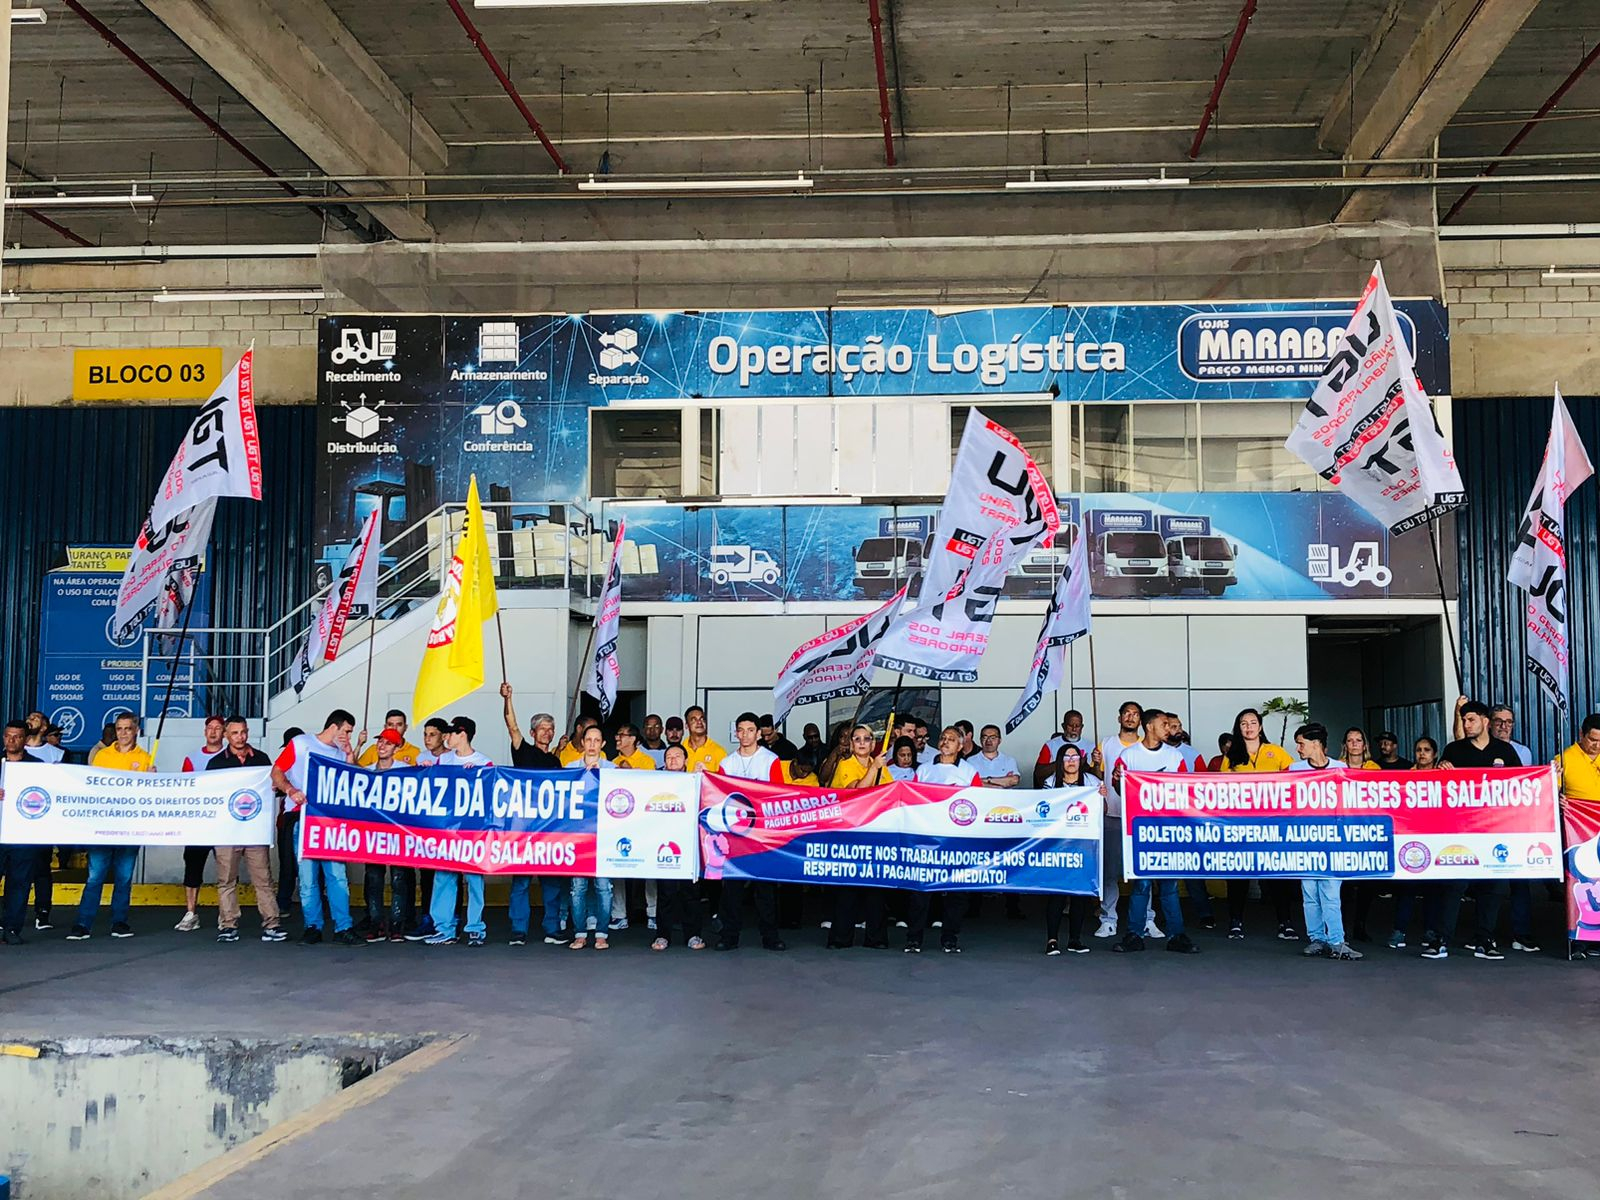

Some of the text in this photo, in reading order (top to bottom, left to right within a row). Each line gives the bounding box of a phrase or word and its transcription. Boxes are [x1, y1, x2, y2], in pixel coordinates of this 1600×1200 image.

[1198, 319, 1230, 330] LOJAS
[707, 333, 1126, 387] Operação Logística
[89, 364, 206, 385] BLOCO 03
[450, 369, 548, 382] Armazenamento
[1198, 366, 1242, 377] PREÇO
[1246, 364, 1296, 374] MENOR
[325, 371, 402, 383] Recebimento
[588, 373, 650, 386] Separação
[327, 442, 398, 455] Distribuição
[463, 440, 534, 452] Conferência
[1441, 493, 1465, 504] UGT
[53, 578, 65, 586] NA
[66, 576, 86, 586] ÁREA
[57, 588, 63, 596] O
[65, 588, 82, 596] USO
[82, 588, 93, 596] DE
[91, 599, 112, 607] COM
[327, 633, 340, 655] UGT
[107, 660, 143, 668] PROIBIDO
[55, 674, 81, 682] USO DE
[109, 674, 135, 682] USO DE
[49, 684, 85, 692] ADORNOS
[102, 684, 140, 692] TELEFONES
[50, 694, 84, 702] PESSOAIS
[102, 694, 141, 702] CELULARES
[85, 776, 196, 788] SECCOR PRESENTE
[316, 765, 450, 817] MARABRAZ
[454, 765, 485, 818] DÁ
[492, 776, 585, 820] CALOTE
[1138, 774, 1542, 812] QUEM SOBREVIVE DOIS MESES SEM SALÁRIOS?
[55, 795, 224, 806] REIVINDICANDO OS DIREITOS DOS
[760, 793, 840, 818] MARABRAZ
[62, 807, 139, 818] COMERCIÁRIOS
[141, 809, 155, 818] DA
[763, 815, 792, 829] PAGUE
[792, 815, 799, 825] O
[800, 810, 817, 823] QUE
[1138, 821, 1389, 843] BOLETOS NÃO ESPERAM. ALUGUEL VENCE.
[309, 825, 576, 867] E NÃO VEM PAGANDO SALÁRIOS
[657, 855, 681, 864] UGT
[806, 842, 1084, 869] DEU CALOTE NOS TRABALHADORES E NOS CLIENTES!
[1138, 851, 1200, 872] DEZEMBRO
[1202, 851, 1255, 872] CHEGOU!
[1257, 851, 1329, 872] PAGAMENTO
[1329, 850, 1390, 871] IMEDIATO!
[1439, 854, 1476, 865] SECFR
[1526, 856, 1553, 865] UGT
[803, 861, 857, 879] RESPEITO
[859, 862, 874, 880] JÁ
[882, 864, 949, 883] PAGAMENTO
[951, 867, 1008, 885] IMEDIATO!
